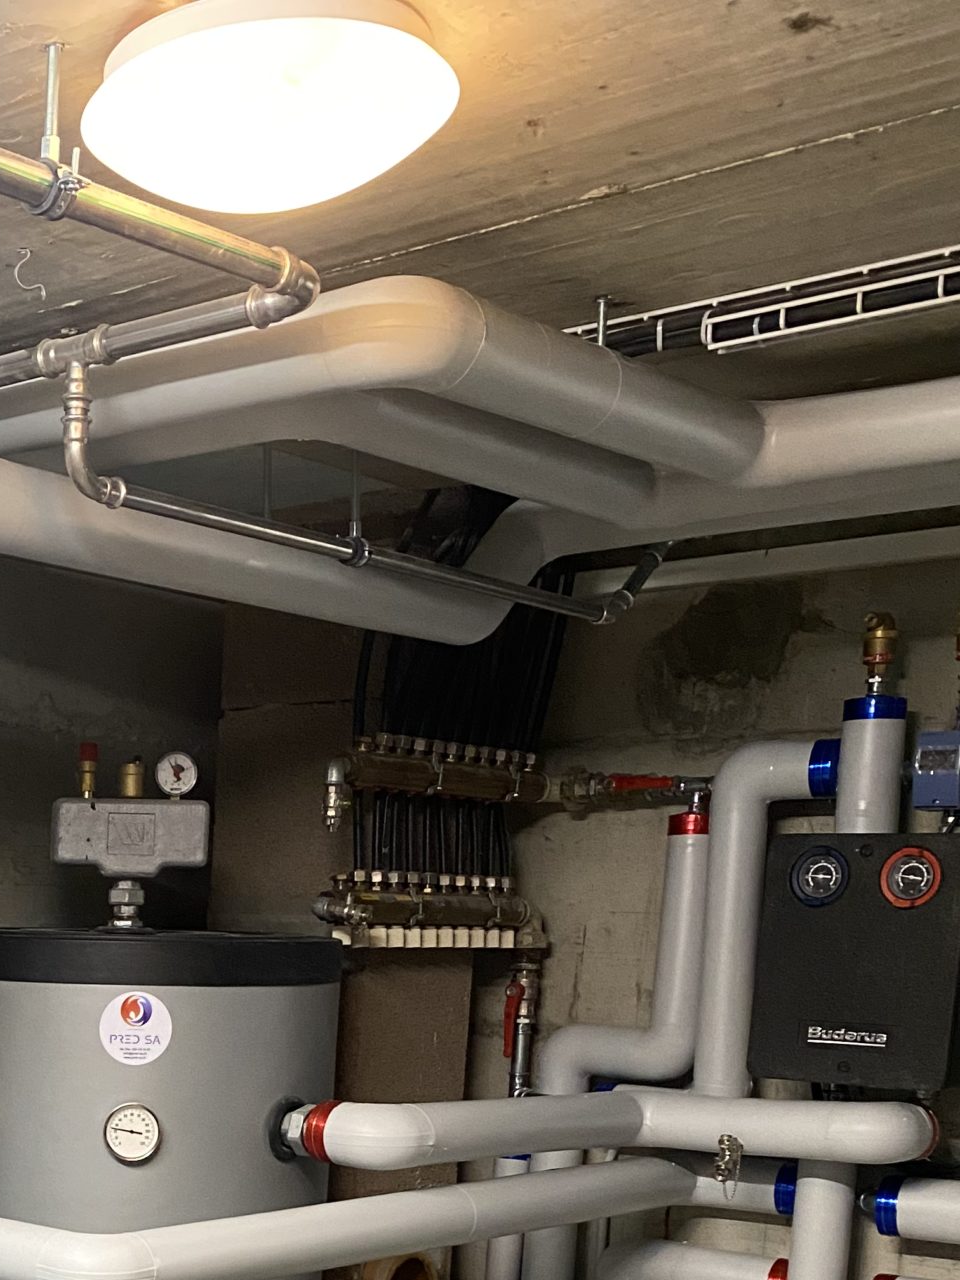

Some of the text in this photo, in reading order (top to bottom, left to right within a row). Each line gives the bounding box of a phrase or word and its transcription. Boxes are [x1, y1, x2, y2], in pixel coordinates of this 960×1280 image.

[109, 1034, 161, 1045] PRED SA
[807, 1026, 888, 1044] Buderus
